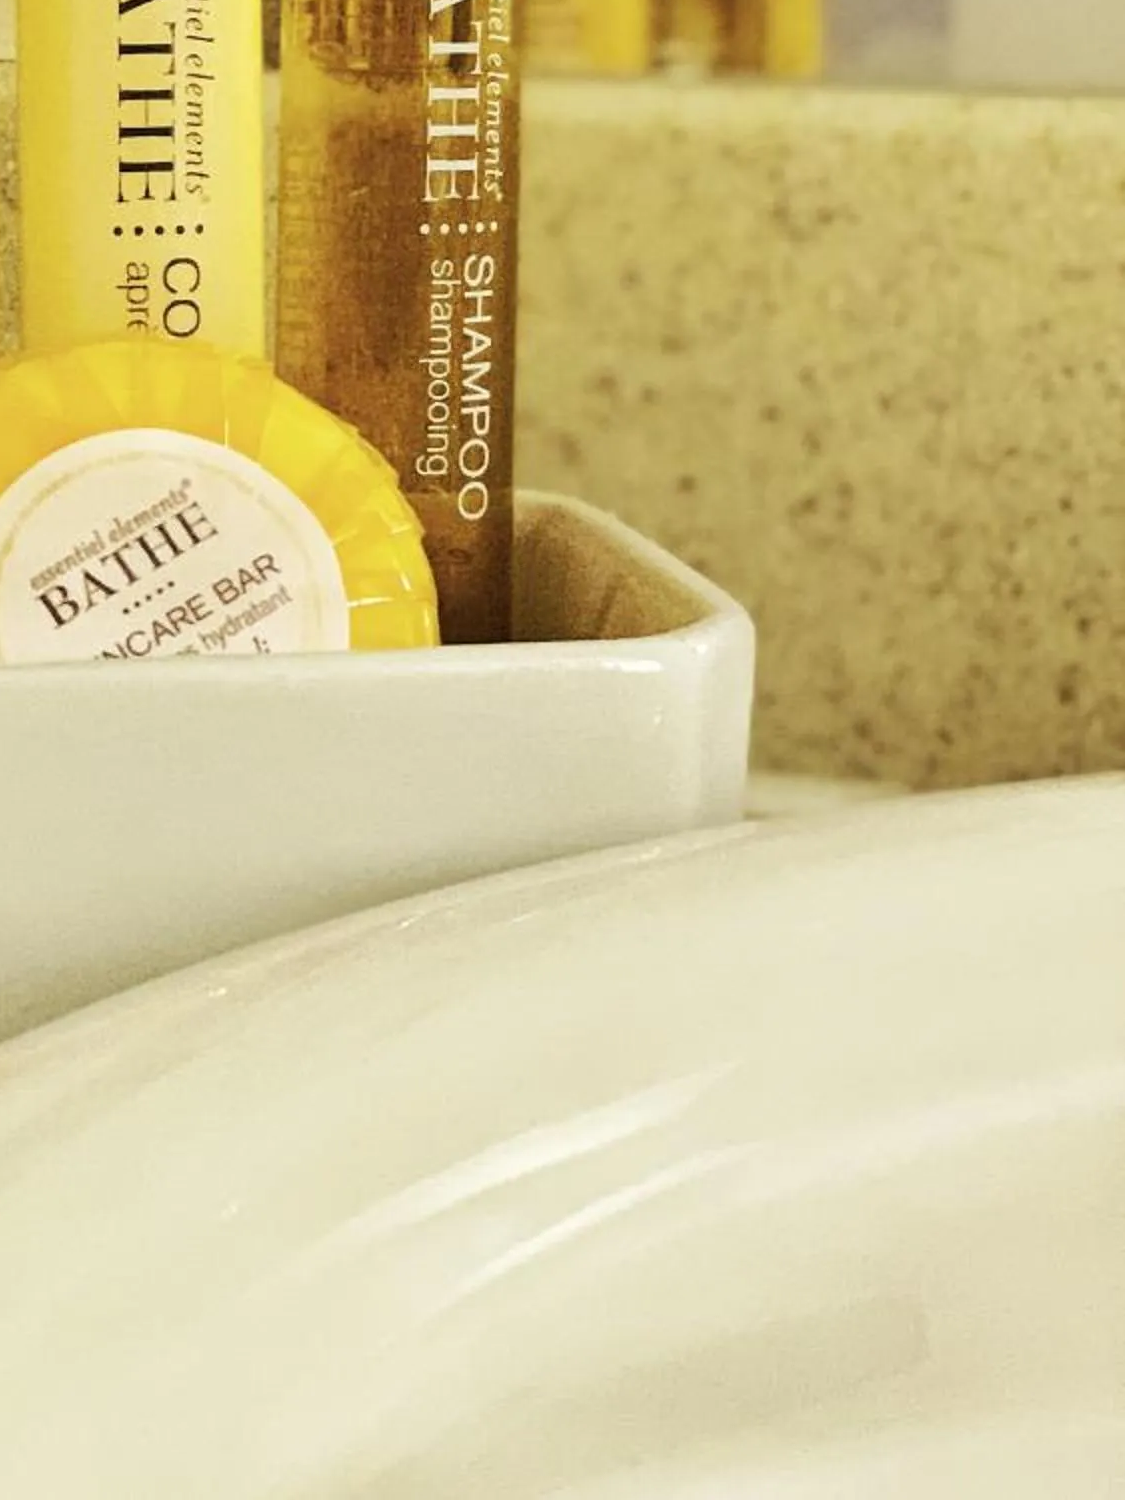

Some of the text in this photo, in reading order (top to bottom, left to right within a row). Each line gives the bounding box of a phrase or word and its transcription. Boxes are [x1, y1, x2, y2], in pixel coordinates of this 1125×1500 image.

[162, 258, 201, 338] CO
[416, 260, 462, 476] shampooing
[457, 254, 494, 521] SHAMPOO
[30, 530, 105, 592] essentiel
[35, 501, 219, 630] BATHE
[212, 553, 281, 606] BAR
[198, 585, 293, 650] hydratant
